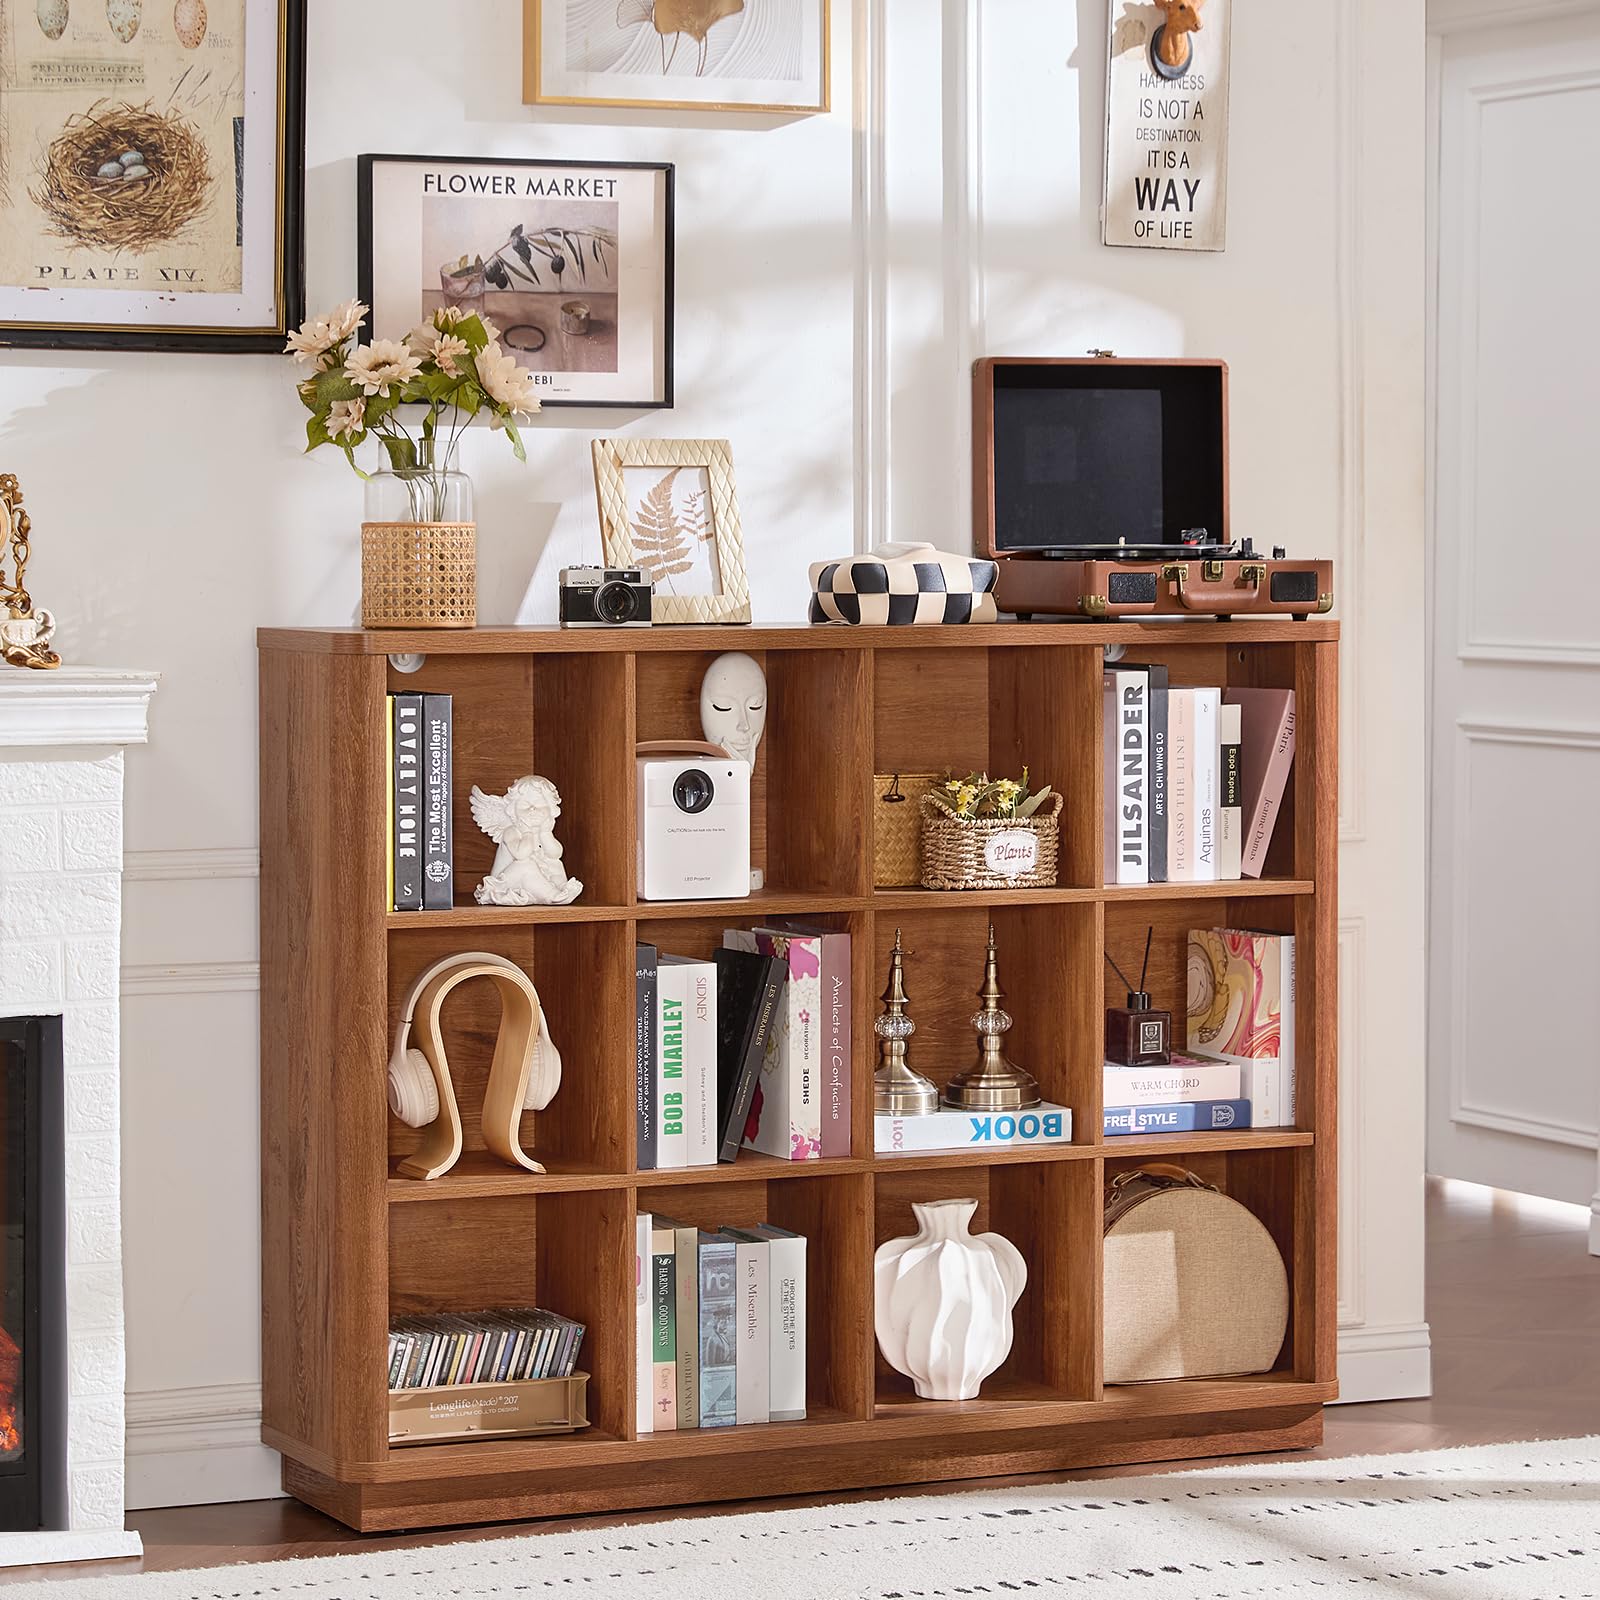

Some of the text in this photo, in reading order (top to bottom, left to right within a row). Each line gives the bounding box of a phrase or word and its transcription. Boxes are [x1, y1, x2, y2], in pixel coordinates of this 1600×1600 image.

[1139, 98, 1204, 120] IS NOT A
[1147, 150, 1190, 169] IT IS A
[423, 174, 617, 198] FLOWER MARKET
[1135, 177, 1201, 212] WAY
[1134, 220, 1193, 239] OF LIFE
[34, 265, 140, 281] PLATE
[1279, 711, 1296, 754] In Paris
[399, 707, 417, 858] LOVELY HOME
[429, 719, 442, 854] The Most Excellent
[1155, 732, 1164, 816] ARTS CHI WING LO
[1228, 748, 1237, 804] Expo Express
[1176, 735, 1185, 870] PICASSO THE LINE
[1200, 808, 1213, 864] Aquinas
[1250, 796, 1274, 862] Jeanne Damas
[994, 843, 1033, 861] Plants
[696, 977, 707, 1022] SIDNEY
[755, 984, 777, 1047] LES MISERABLES
[829, 975, 843, 1120] Analects of Confucius
[637, 1075, 643, 1086] TO
[662, 998, 683, 1136] BOB MARLEY
[1131, 1078, 1200, 1091] WARM CHORD
[644, 1097, 650, 1111] AN
[802, 1068, 810, 1105] SHEDE
[893, 1119, 903, 1150] 2011
[970, 1113, 1063, 1142] BOOK
[1138, 1113, 1178, 1126] STYLE
[747, 1258, 758, 1340] Les Miserables
[783, 1278, 789, 1289] OF
[430, 1398, 472, 1412] Longlife
[504, 1396, 519, 1405] 207
